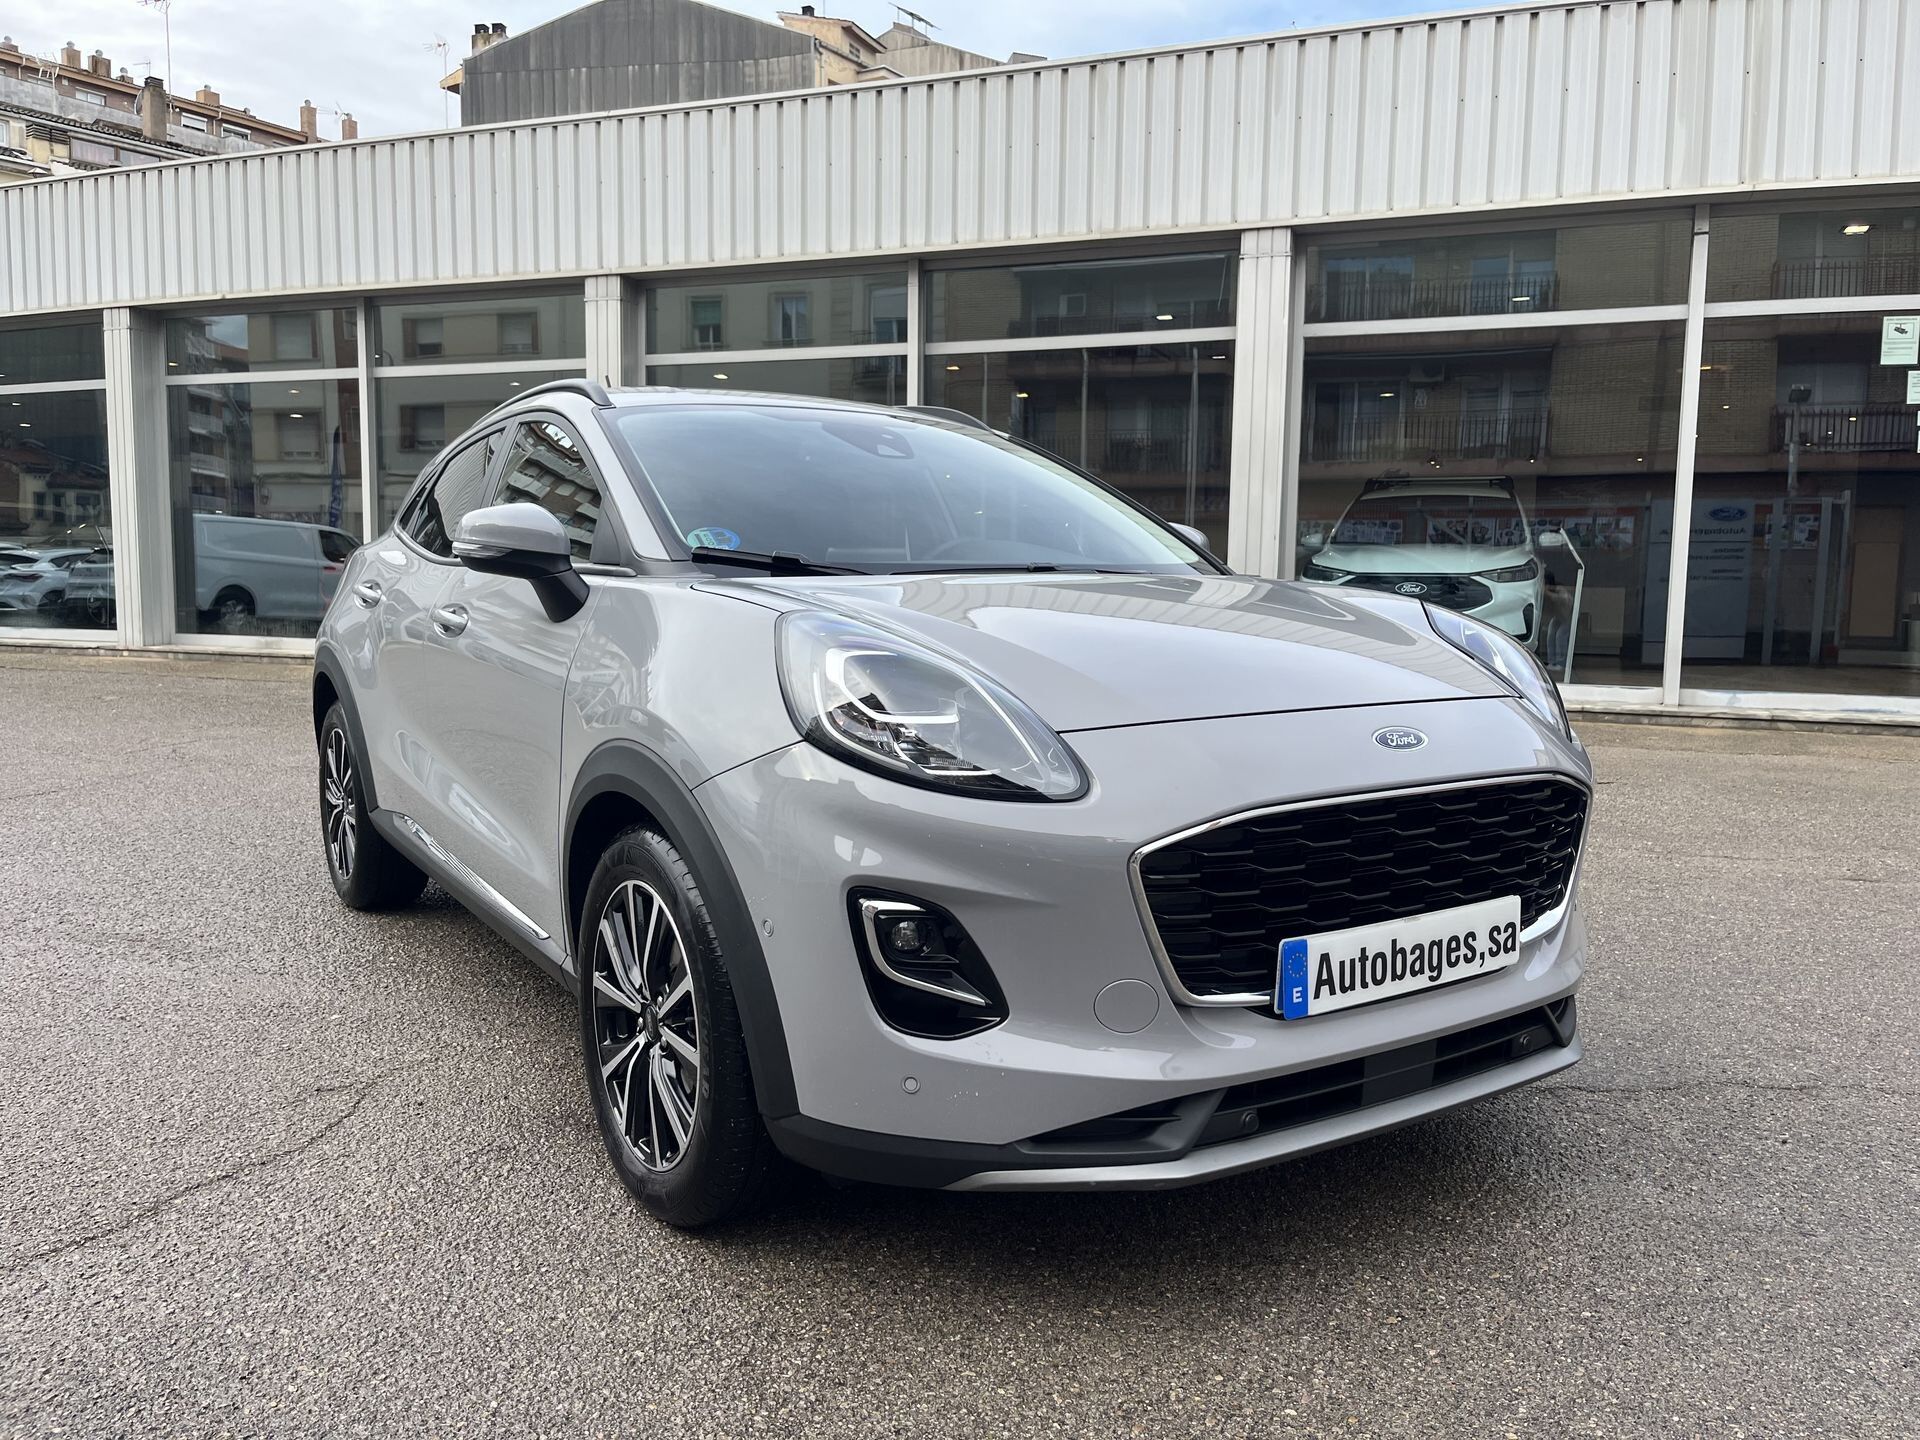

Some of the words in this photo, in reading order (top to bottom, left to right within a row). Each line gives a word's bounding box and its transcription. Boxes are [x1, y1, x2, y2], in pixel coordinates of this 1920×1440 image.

[1400, 583, 1421, 594] Ford
[1386, 731, 1418, 746] Ford
[1293, 986, 1303, 1004] E
